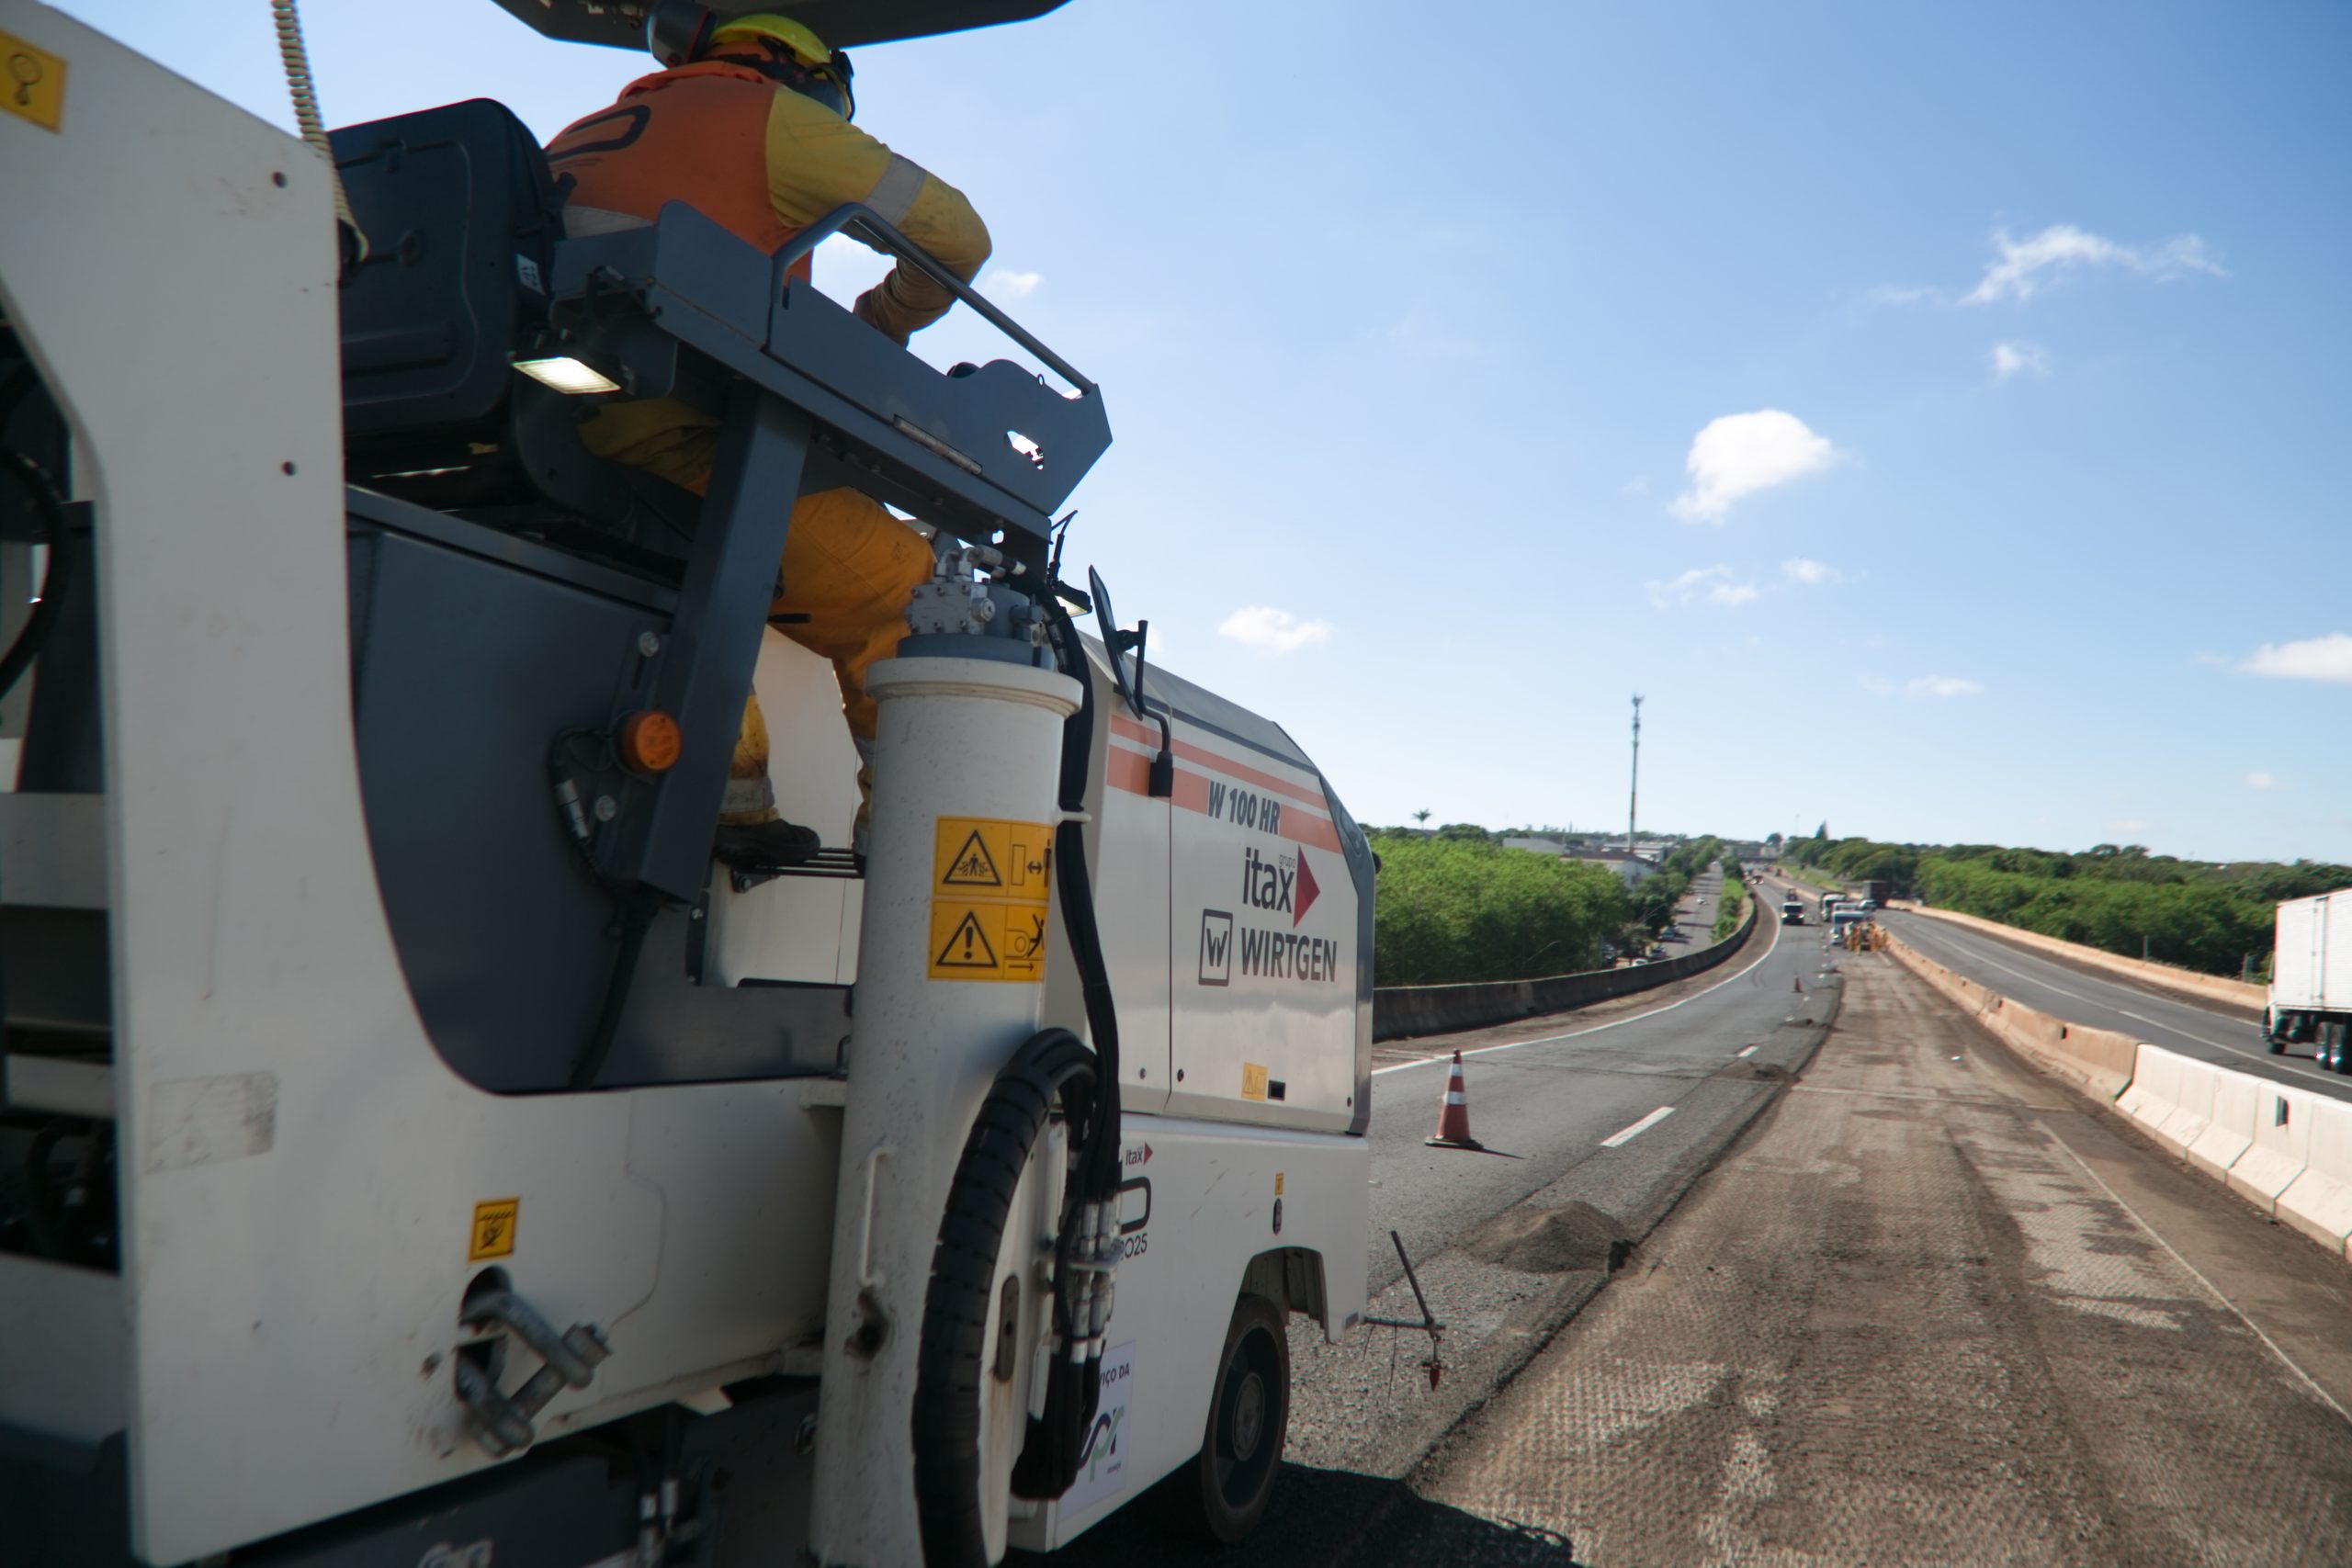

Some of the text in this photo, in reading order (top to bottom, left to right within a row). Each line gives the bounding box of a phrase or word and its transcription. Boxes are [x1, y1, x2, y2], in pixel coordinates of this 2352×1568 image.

[1208, 780, 1281, 835] W 100 HR
[1243, 847, 1295, 914] itax
[1241, 927, 1337, 982] WIRTGEN
[1118, 1362, 1130, 1379] DA
